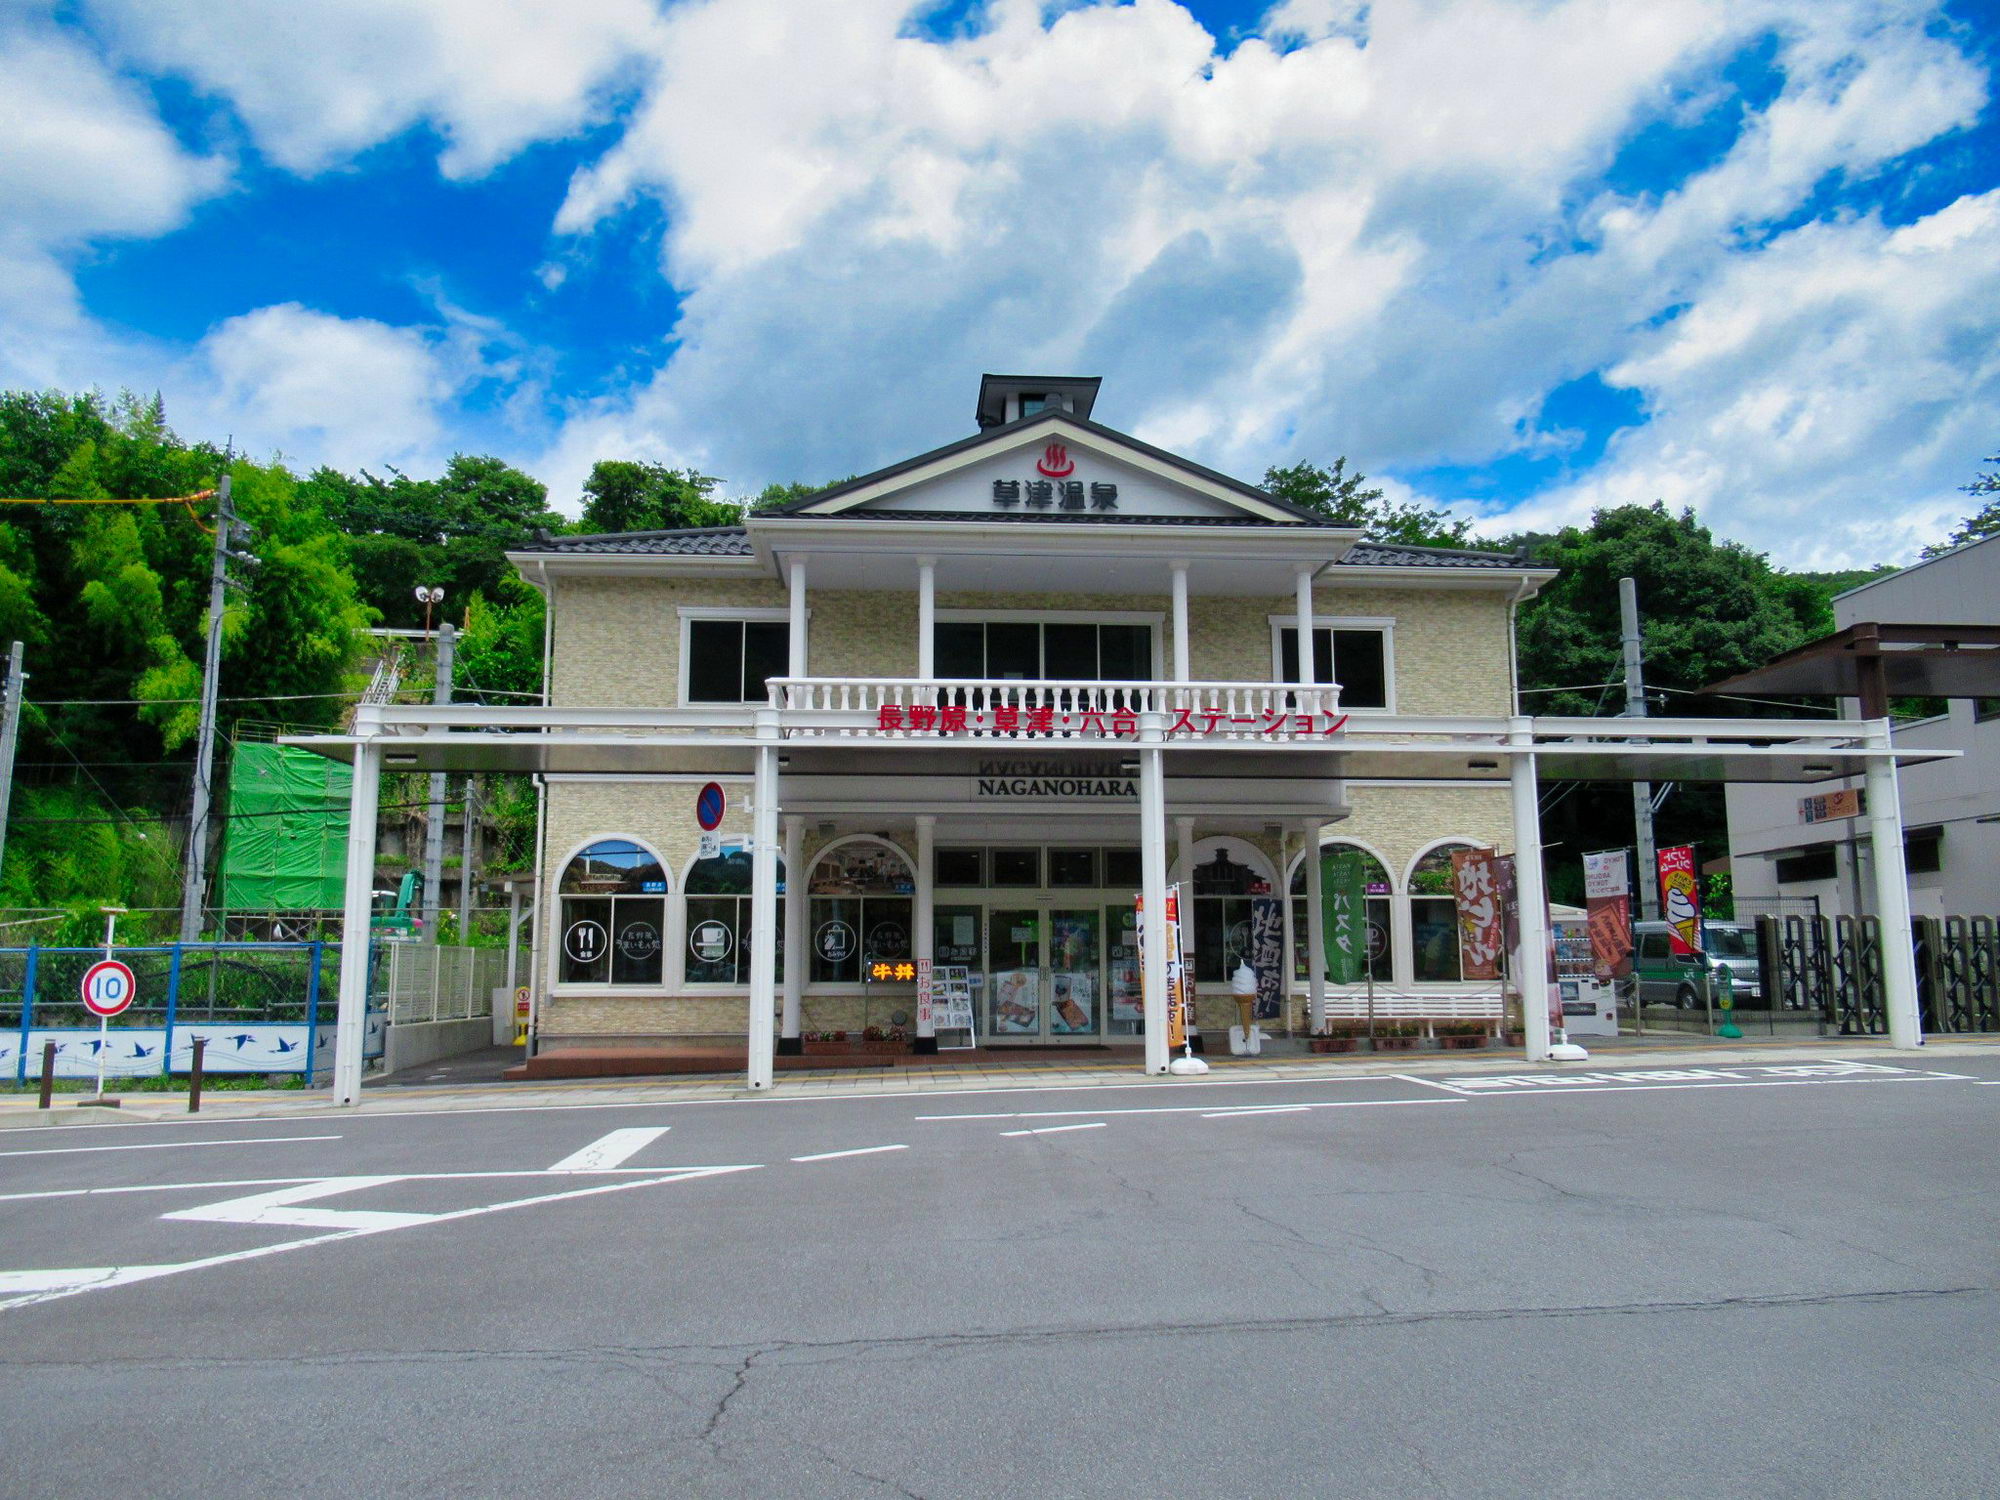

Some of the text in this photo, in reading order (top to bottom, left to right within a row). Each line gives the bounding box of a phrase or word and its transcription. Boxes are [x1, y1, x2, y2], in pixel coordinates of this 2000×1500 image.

[992, 479, 1119, 511] 草津温泉
[1168, 708, 1349, 735] ステーション
[978, 779, 1138, 796] NAGANOHARA
[872, 963, 915, 981] 牛丼
[96, 977, 122, 999] 10
[918, 976, 932, 1021] お食事
